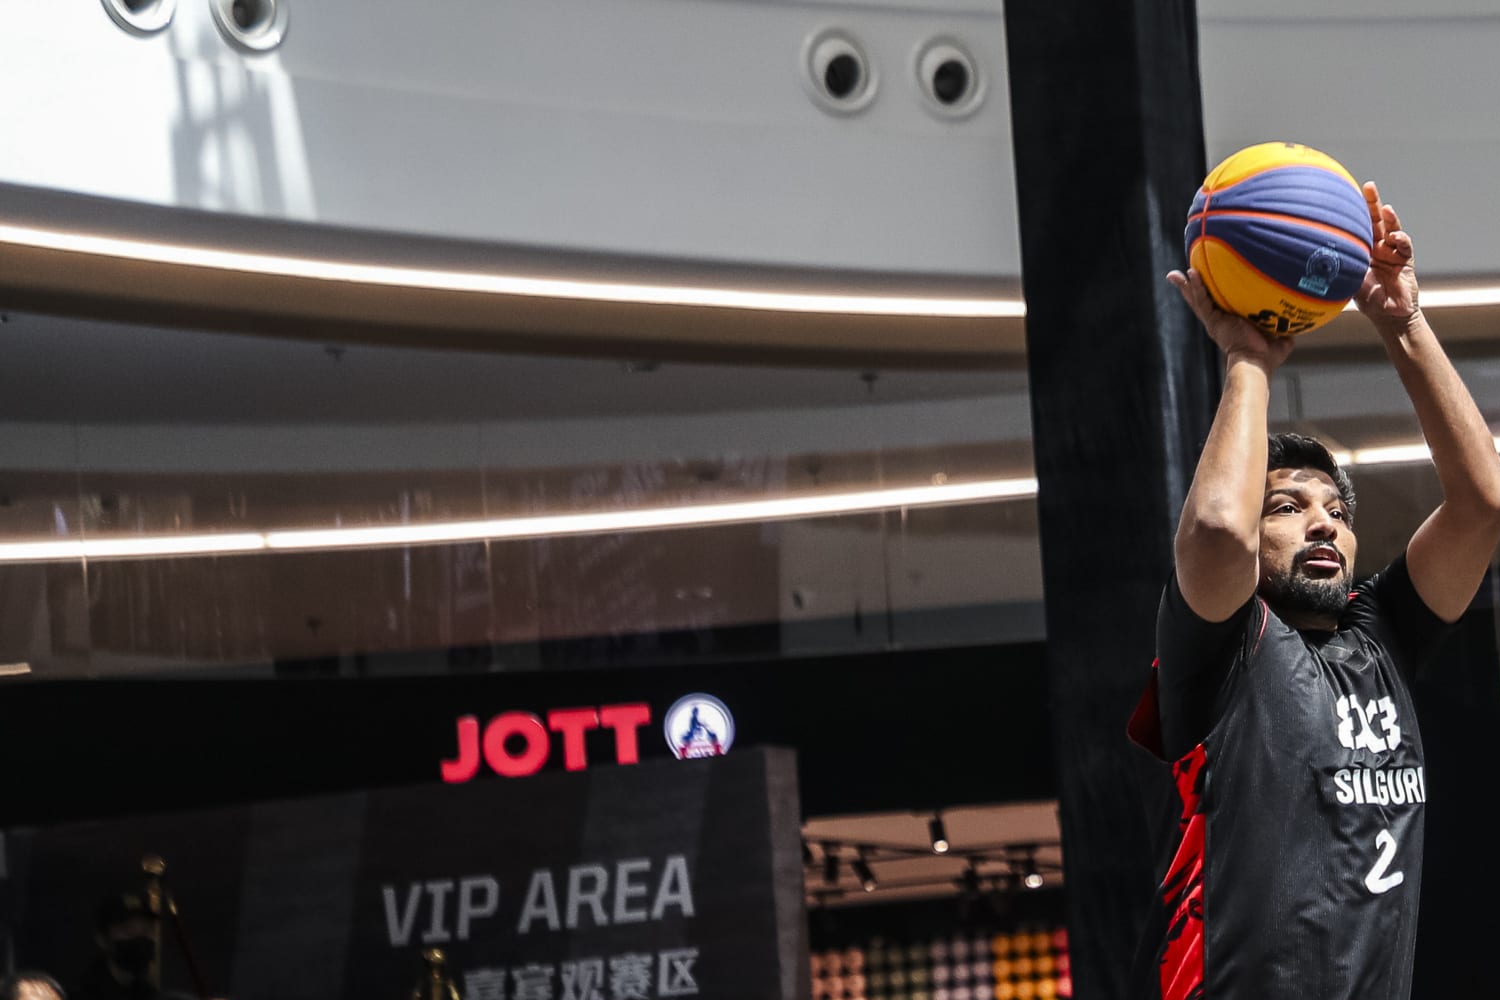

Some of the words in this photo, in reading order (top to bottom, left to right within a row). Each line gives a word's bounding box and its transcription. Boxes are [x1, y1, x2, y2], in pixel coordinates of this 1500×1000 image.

[440, 701, 651, 783] JOTT
[382, 873, 499, 947] VIP
[517, 852, 695, 934] AREA
[1365, 828, 1404, 894] 2
